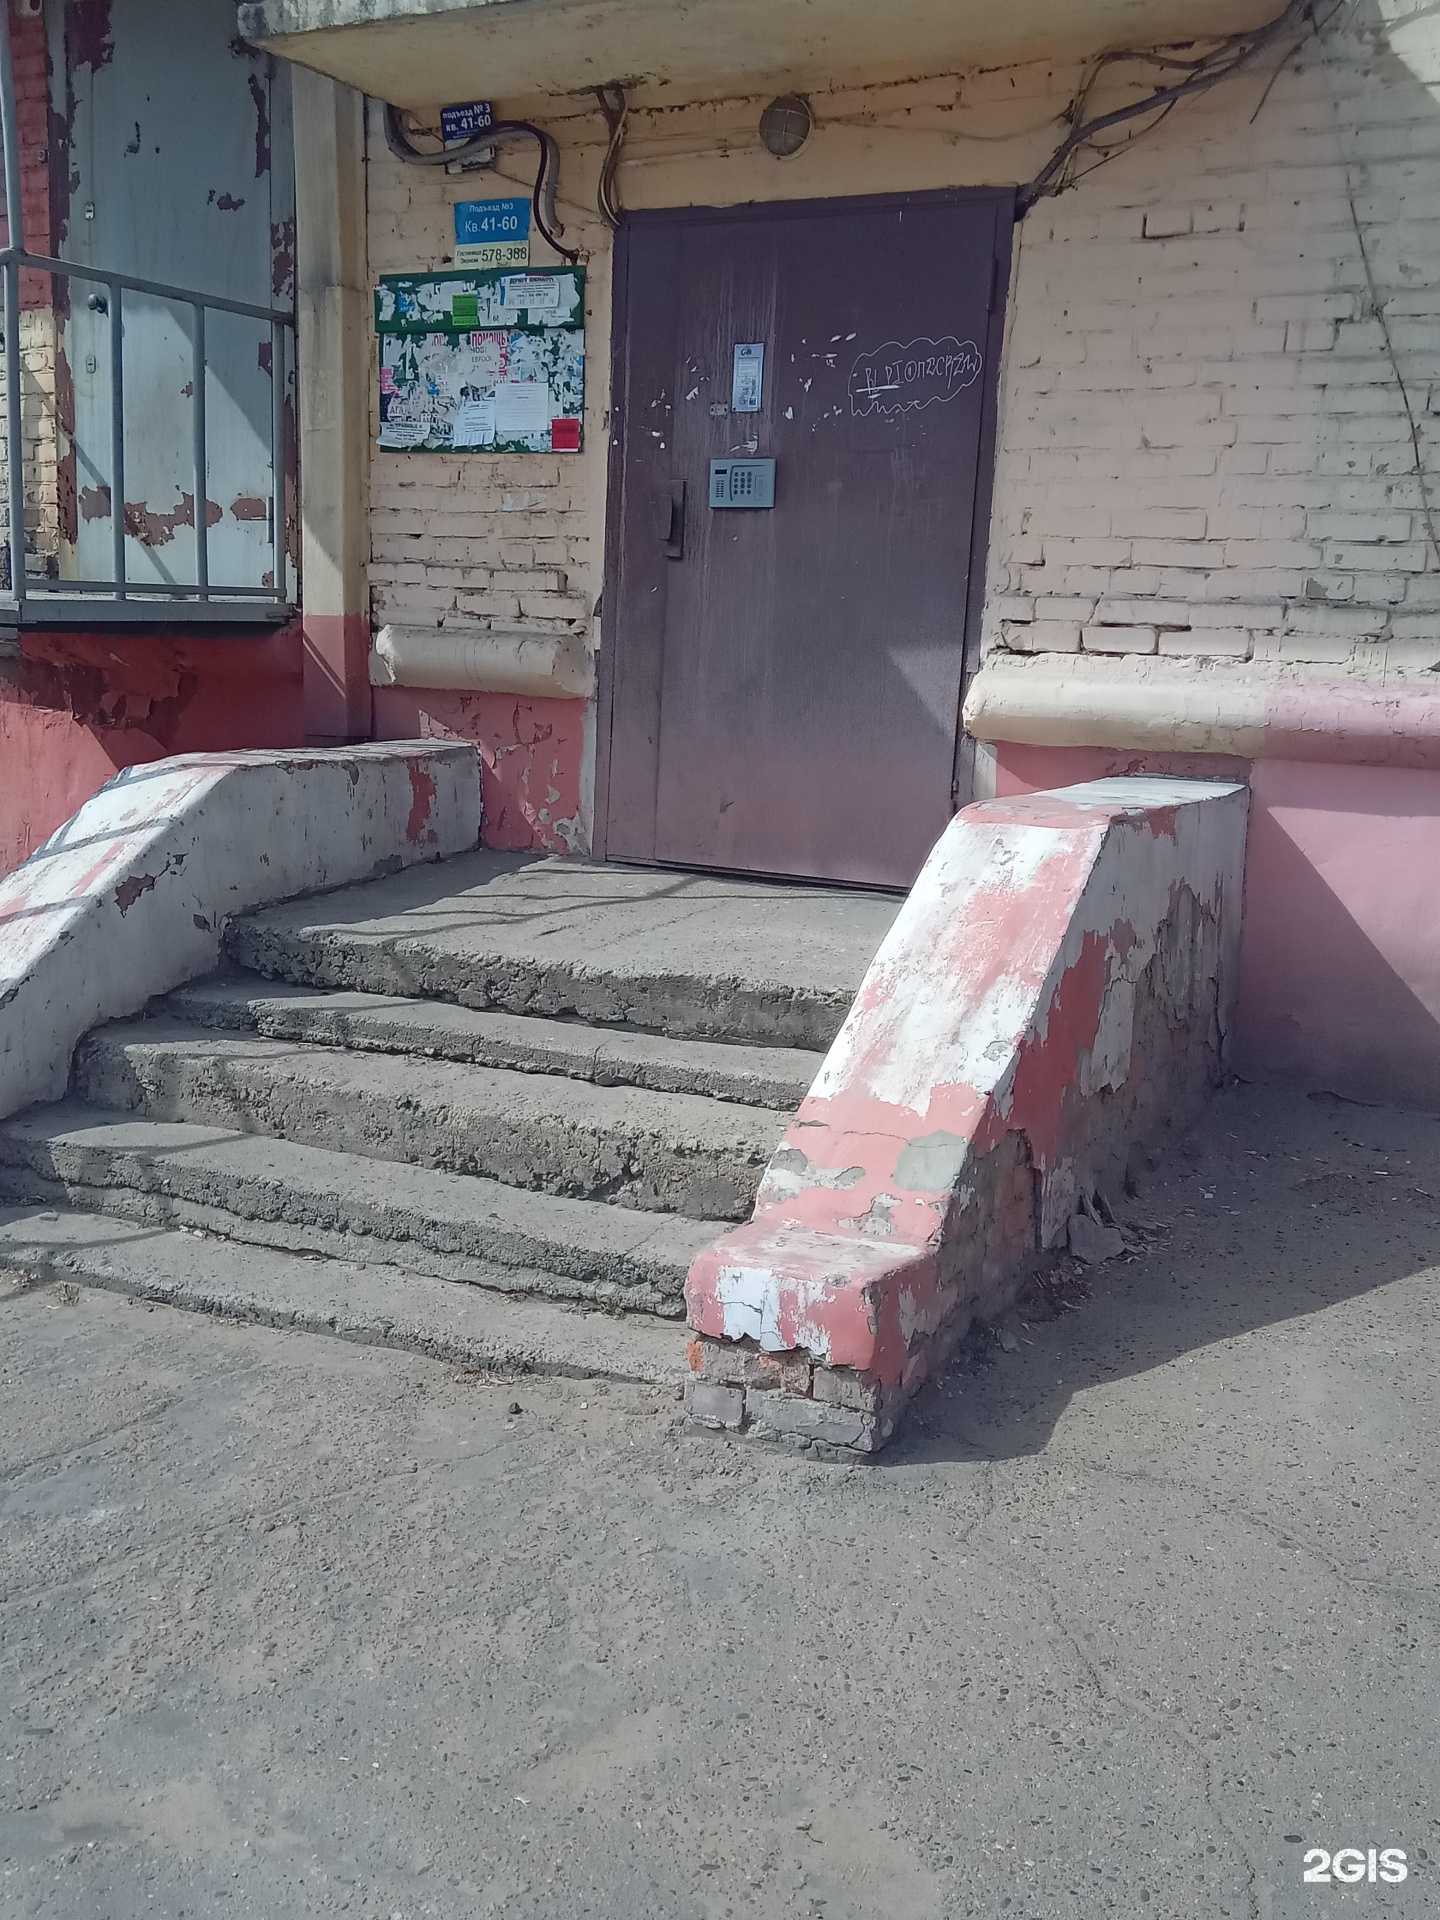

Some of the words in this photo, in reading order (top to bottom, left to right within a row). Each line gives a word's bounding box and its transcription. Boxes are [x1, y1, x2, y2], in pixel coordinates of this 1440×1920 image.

[443, 109, 473, 121] подъезд
[484, 103, 491, 114] 3
[446, 123, 460, 132] кв.
[460, 115, 491, 129] 41-60
[469, 205, 500, 214] Подъезд
[481, 247, 527, 262] 578-388
